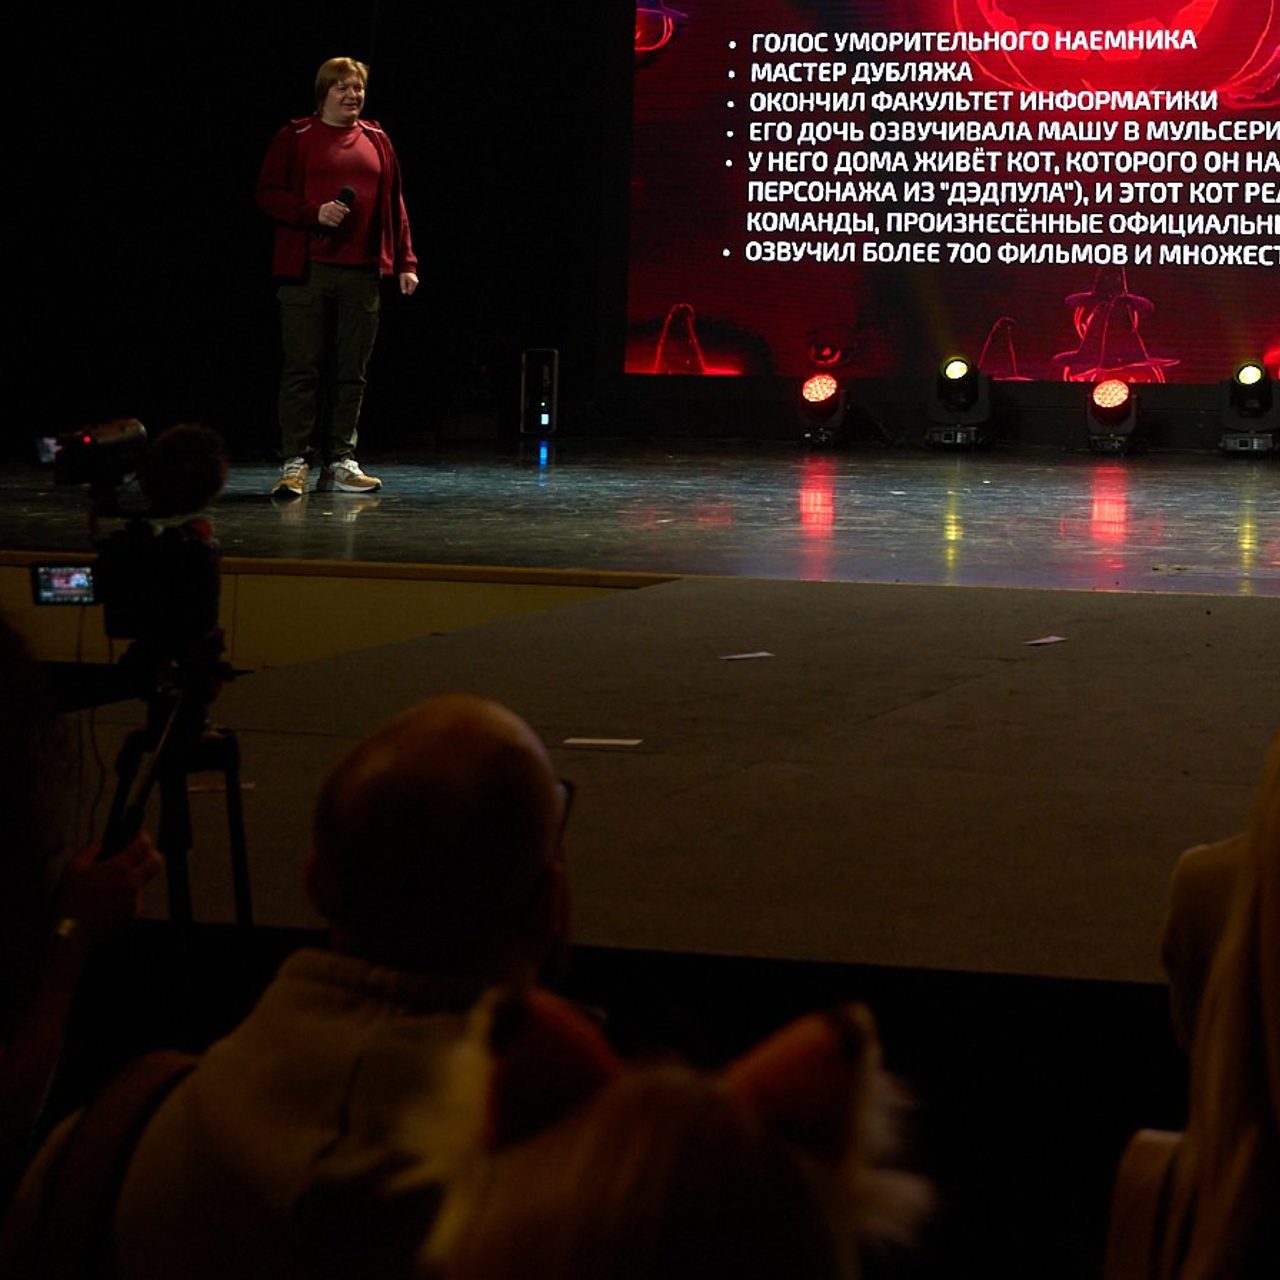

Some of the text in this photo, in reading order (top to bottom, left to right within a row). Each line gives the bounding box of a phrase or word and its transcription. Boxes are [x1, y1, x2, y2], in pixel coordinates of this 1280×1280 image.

[752, 29, 1198, 53] ГОЛОС УМОРИТЕЛЬНОГО НАЕМНИКА
[751, 61, 974, 85] МАСТЕР ДУБЛЯЖА
[749, 89, 1218, 112] ОКОНЧИЛ ФАКУЛЬТЕТ ИНФОРМАТИКИ
[749, 121, 793, 142] ЕГО
[796, 121, 864, 146] ДОЧЬ
[869, 120, 1033, 142] ОЗВУЧИВАЛА
[1037, 120, 1119, 141] МАШУ
[1124, 120, 1140, 141] В
[748, 151, 763, 172] У
[768, 150, 828, 172] НЕГО
[833, 150, 910, 176] ДОМА
[912, 146, 1003, 172] ЖИВЁТ
[1007, 150, 1060, 175] КОТ,
[1065, 150, 1198, 173] КОТОРОГО
[1203, 150, 1240, 173] ОН
[748, 180, 898, 202] ПЕРСОНАЖА
[903, 181, 936, 202] ИЗ
[1095, 182, 1113, 204] И
[1118, 182, 1184, 204] ЭТОТ
[1189, 182, 1240, 204] КОТ
[746, 211, 880, 236] КОМАНДЫ,
[886, 208, 1104, 234] ПРОИЗНЕСЁННЫЕ
[745, 240, 856, 262] ОЗВУЧИЛ
[862, 242, 941, 263] БОЛЕЕ
[946, 242, 991, 264] 700
[997, 242, 1129, 265] ФИЛЬМОВ
[1134, 243, 1152, 265] И
